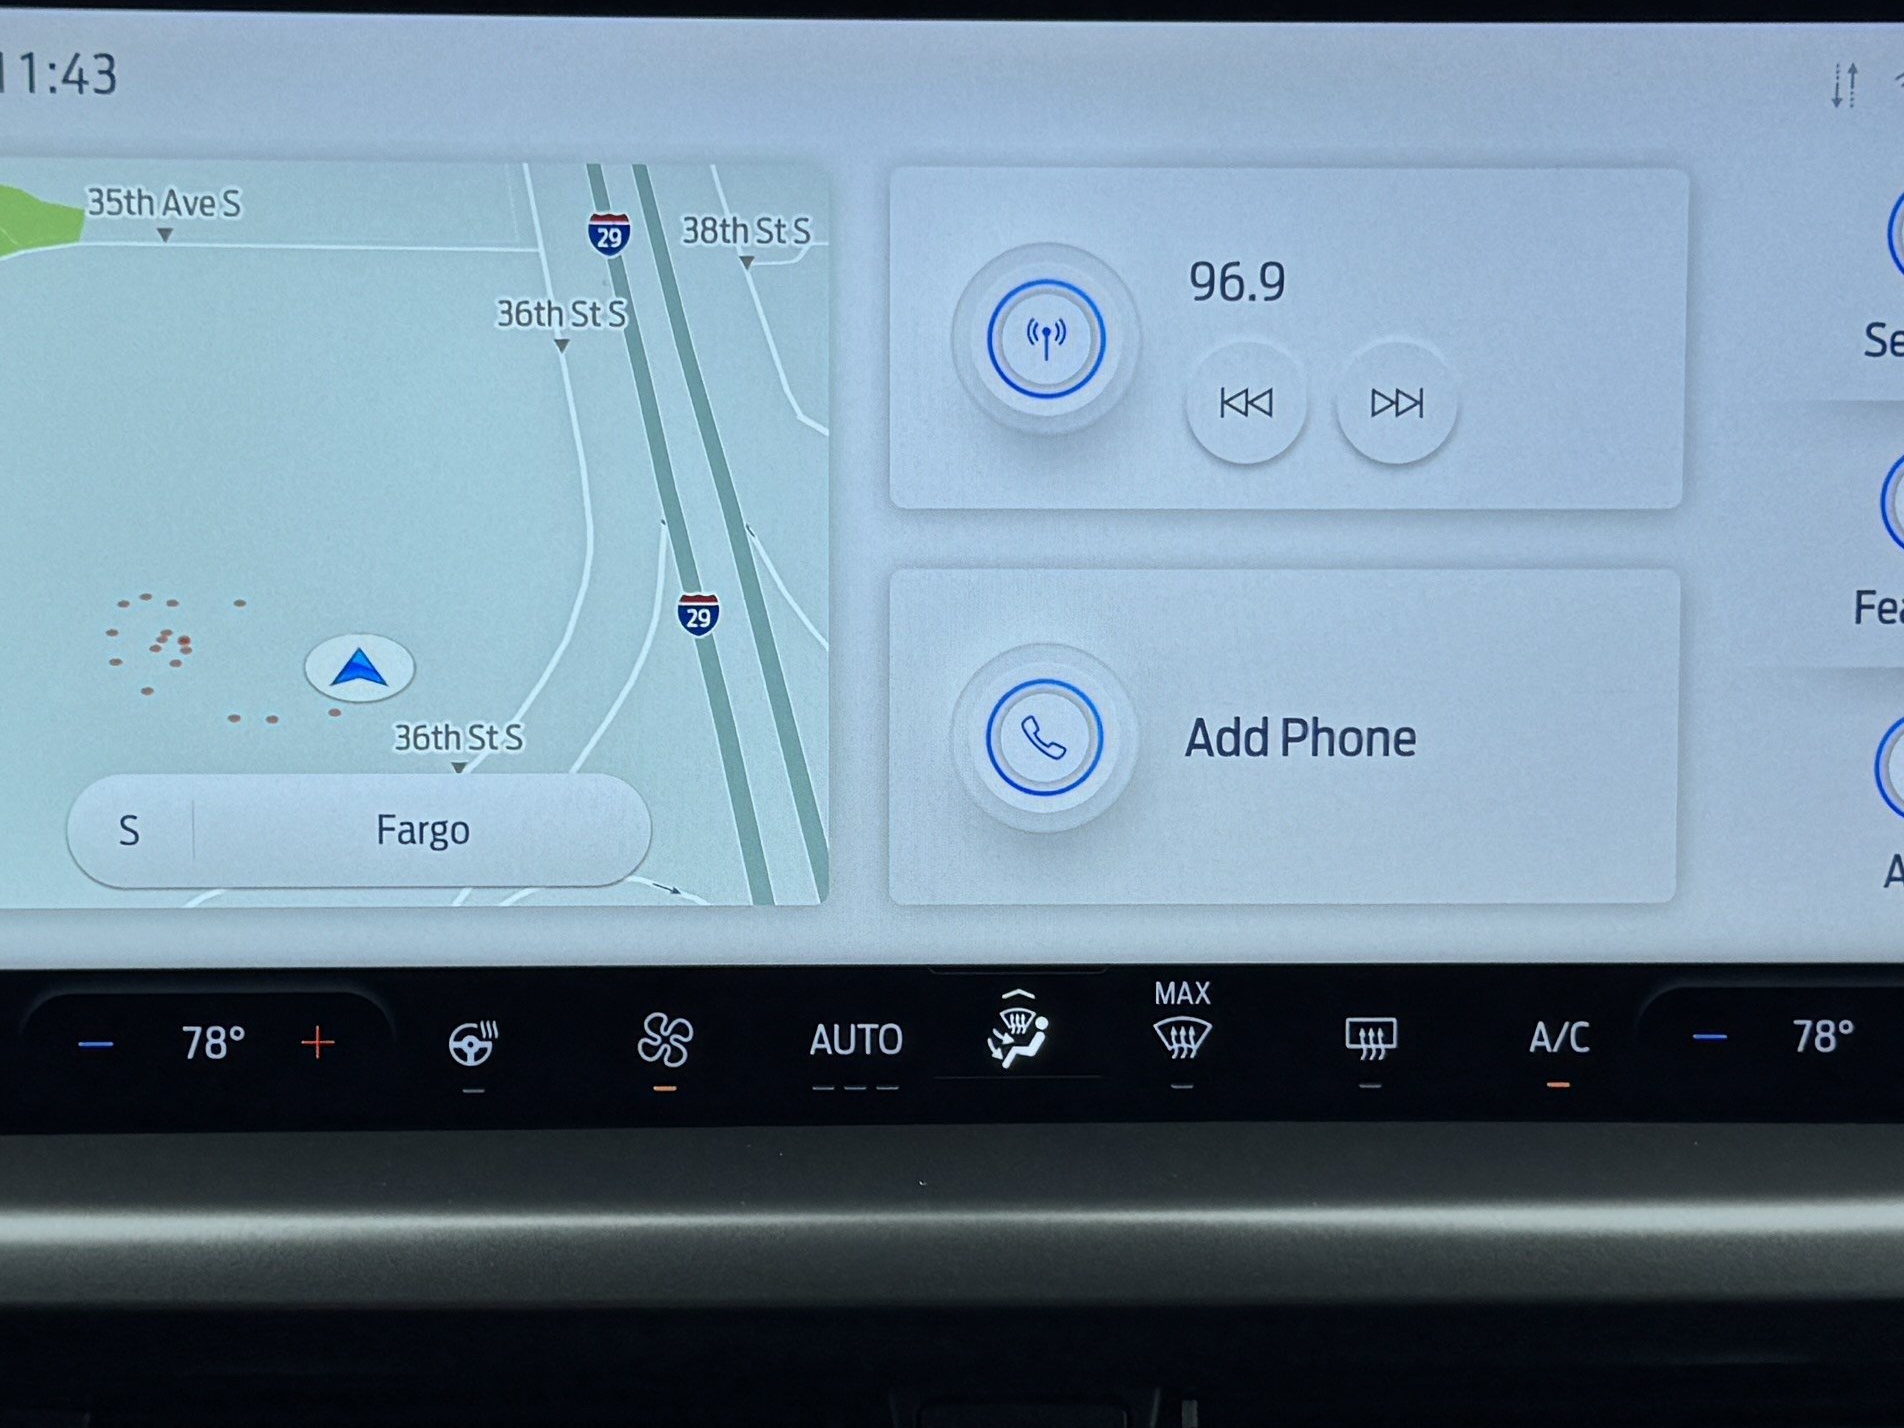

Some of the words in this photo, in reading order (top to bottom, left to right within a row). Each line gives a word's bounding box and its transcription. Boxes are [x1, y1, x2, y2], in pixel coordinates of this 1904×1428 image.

[89, 188, 153, 215] 35th
[163, 189, 215, 216] Ave
[223, 190, 240, 216] S
[597, 227, 622, 248] 29
[684, 217, 748, 243] 38th
[757, 217, 786, 243] St
[794, 218, 810, 244] S
[1191, 261, 1284, 301] 96.9
[499, 300, 562, 326] 36th
[572, 301, 601, 327] St
[610, 301, 627, 327] S
[686, 608, 711, 628] 29
[396, 724, 460, 750] 36th
[469, 724, 498, 750] St
[506, 724, 522, 750] S
[1185, 716, 1268, 757] Add
[1282, 717, 1416, 756] Phone
[120, 815, 139, 845] S
[379, 814, 469, 851] Fargo
[1156, 980, 1210, 1005] MAX
[183, 1026, 244, 1059] 78°
[810, 1023, 902, 1055] AUTO
[1530, 1021, 1589, 1052] A/C
[1794, 1020, 1854, 1052] 78°
